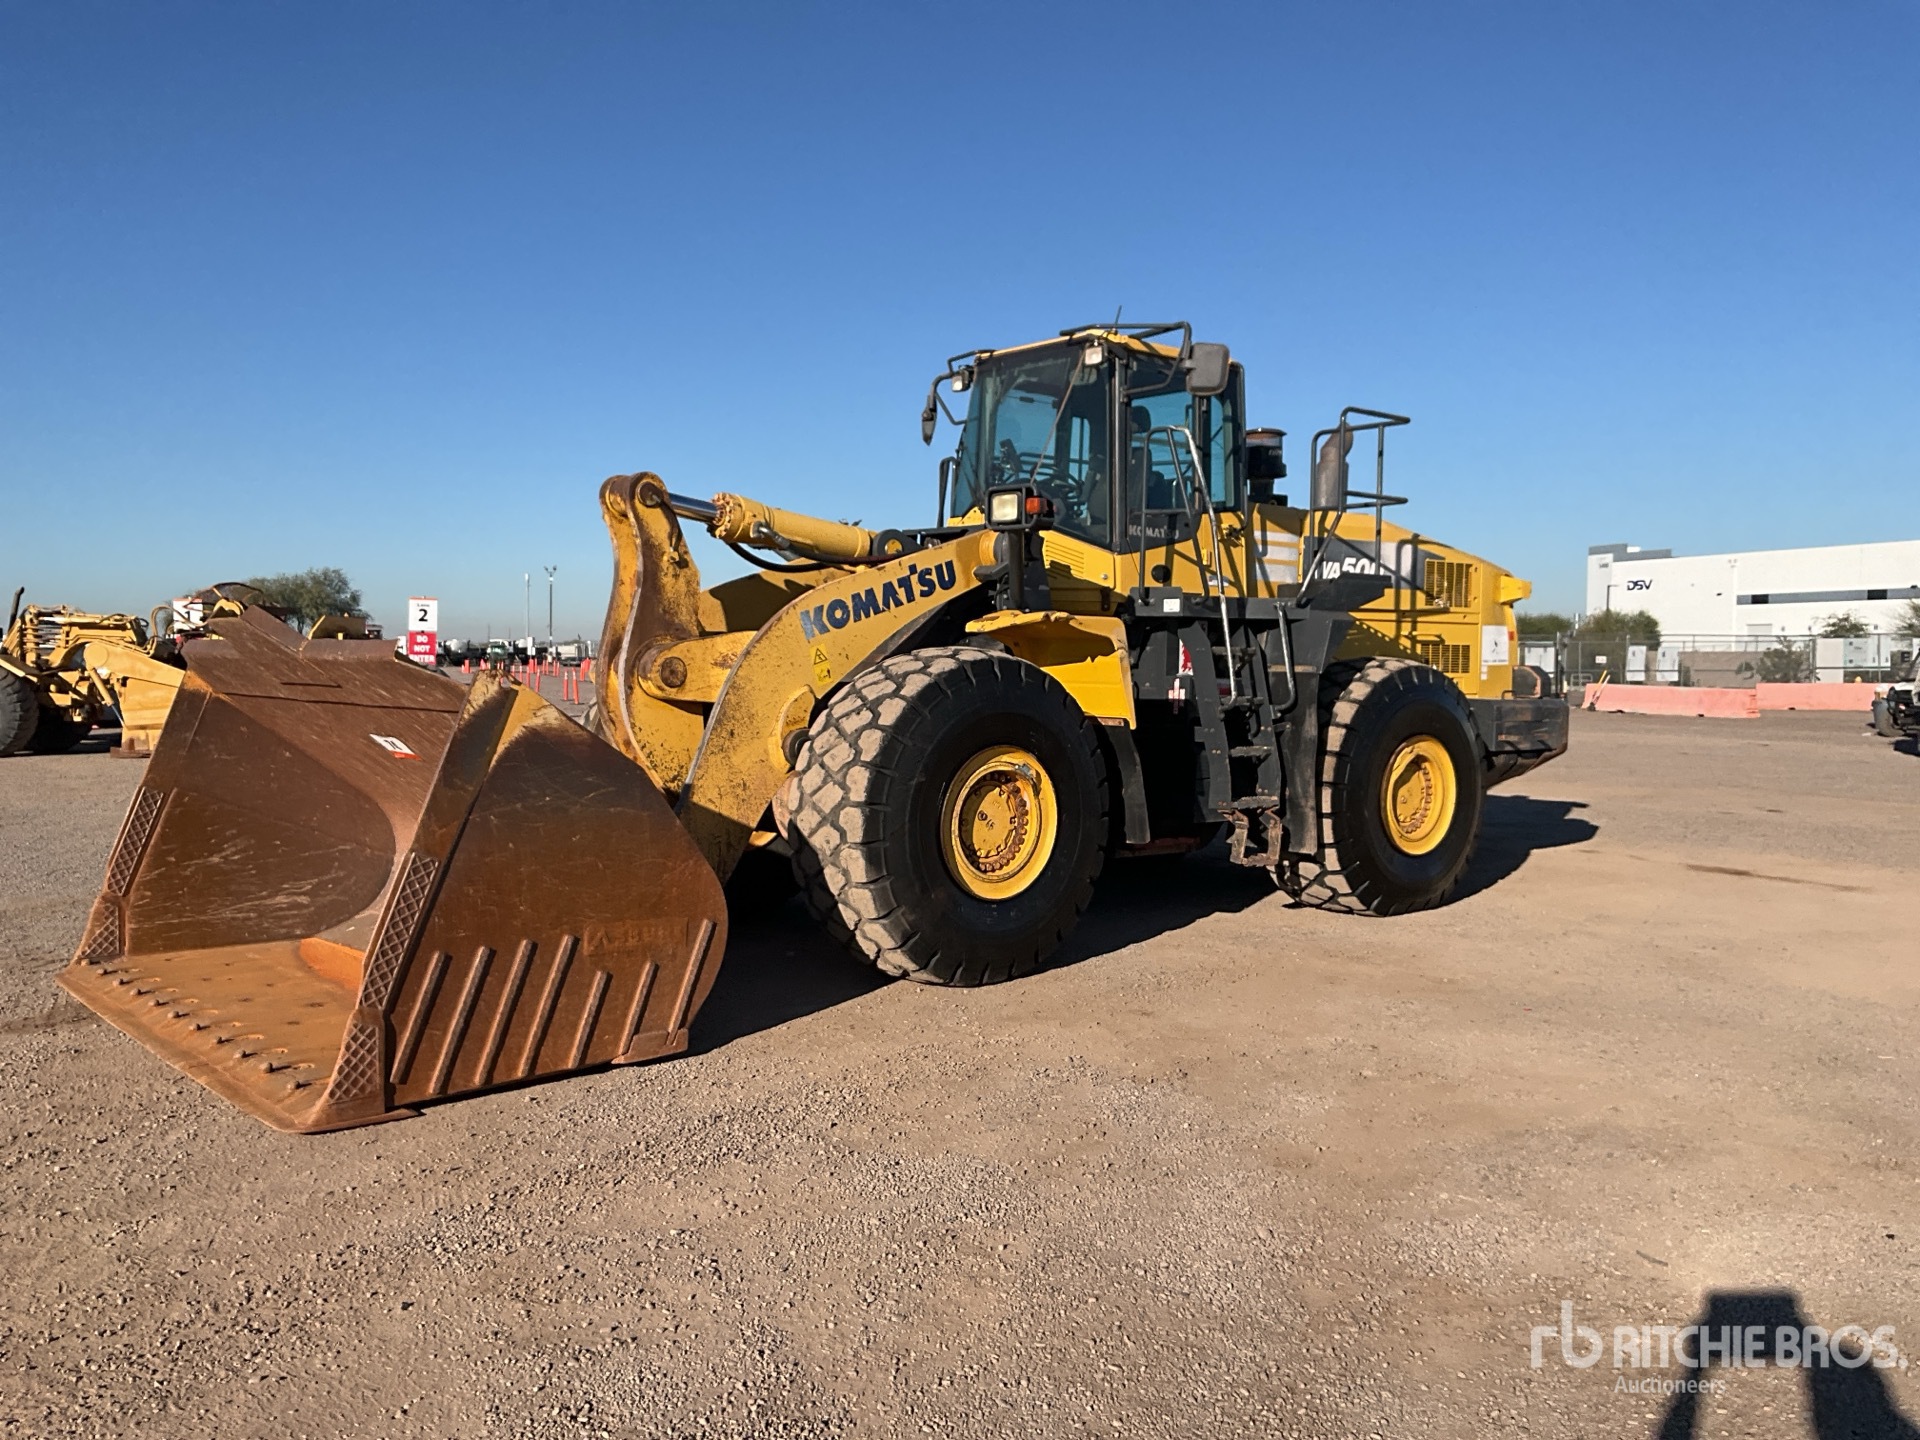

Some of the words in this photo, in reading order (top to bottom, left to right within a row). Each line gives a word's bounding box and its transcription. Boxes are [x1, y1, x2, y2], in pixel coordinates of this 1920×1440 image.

[1627, 579, 1653, 591] DSV
[800, 559, 957, 640] KOMATSU
[418, 608, 428, 622] 2
[416, 635, 429, 643] DO
[413, 644, 430, 653] NOT
